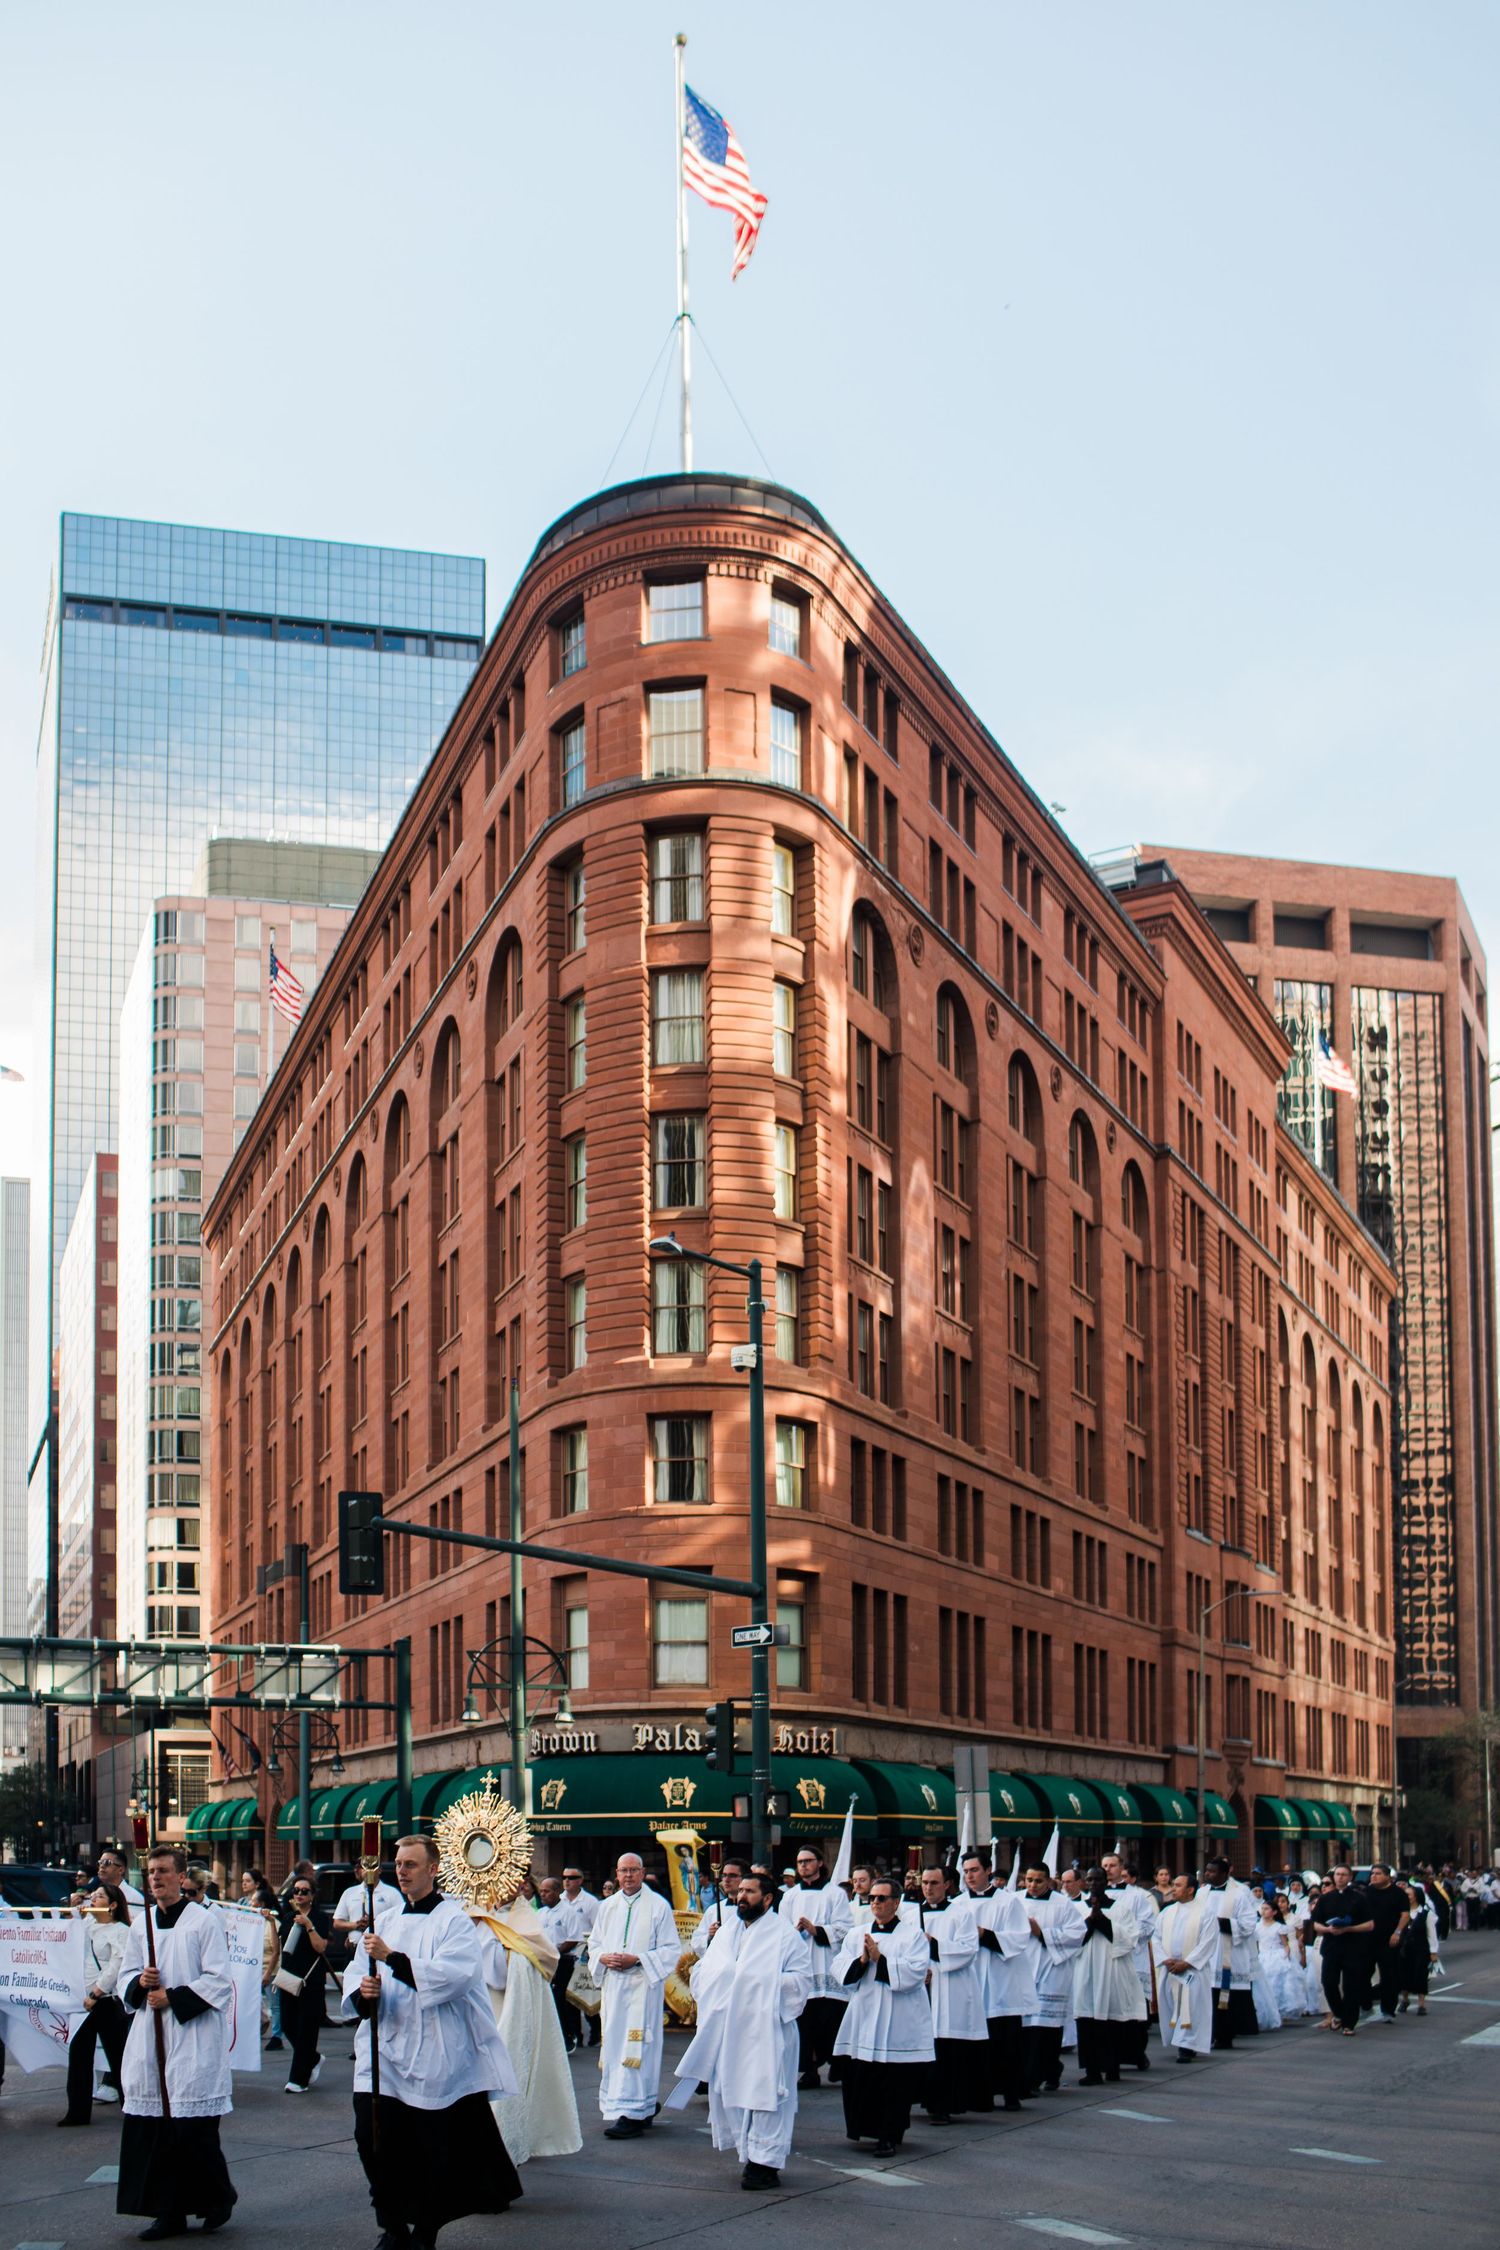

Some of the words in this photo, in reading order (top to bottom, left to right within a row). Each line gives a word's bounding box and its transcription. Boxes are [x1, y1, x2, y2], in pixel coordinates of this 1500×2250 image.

[530, 1729, 597, 1755] Brown
[772, 1724, 838, 1754] Hotel
[649, 1820, 679, 1832] Palace
[681, 1820, 707, 1831] Arms
[12, 1972, 38, 1988] Familia
[39, 1976, 47, 1989] de
[49, 1979, 71, 1997] Greeley
